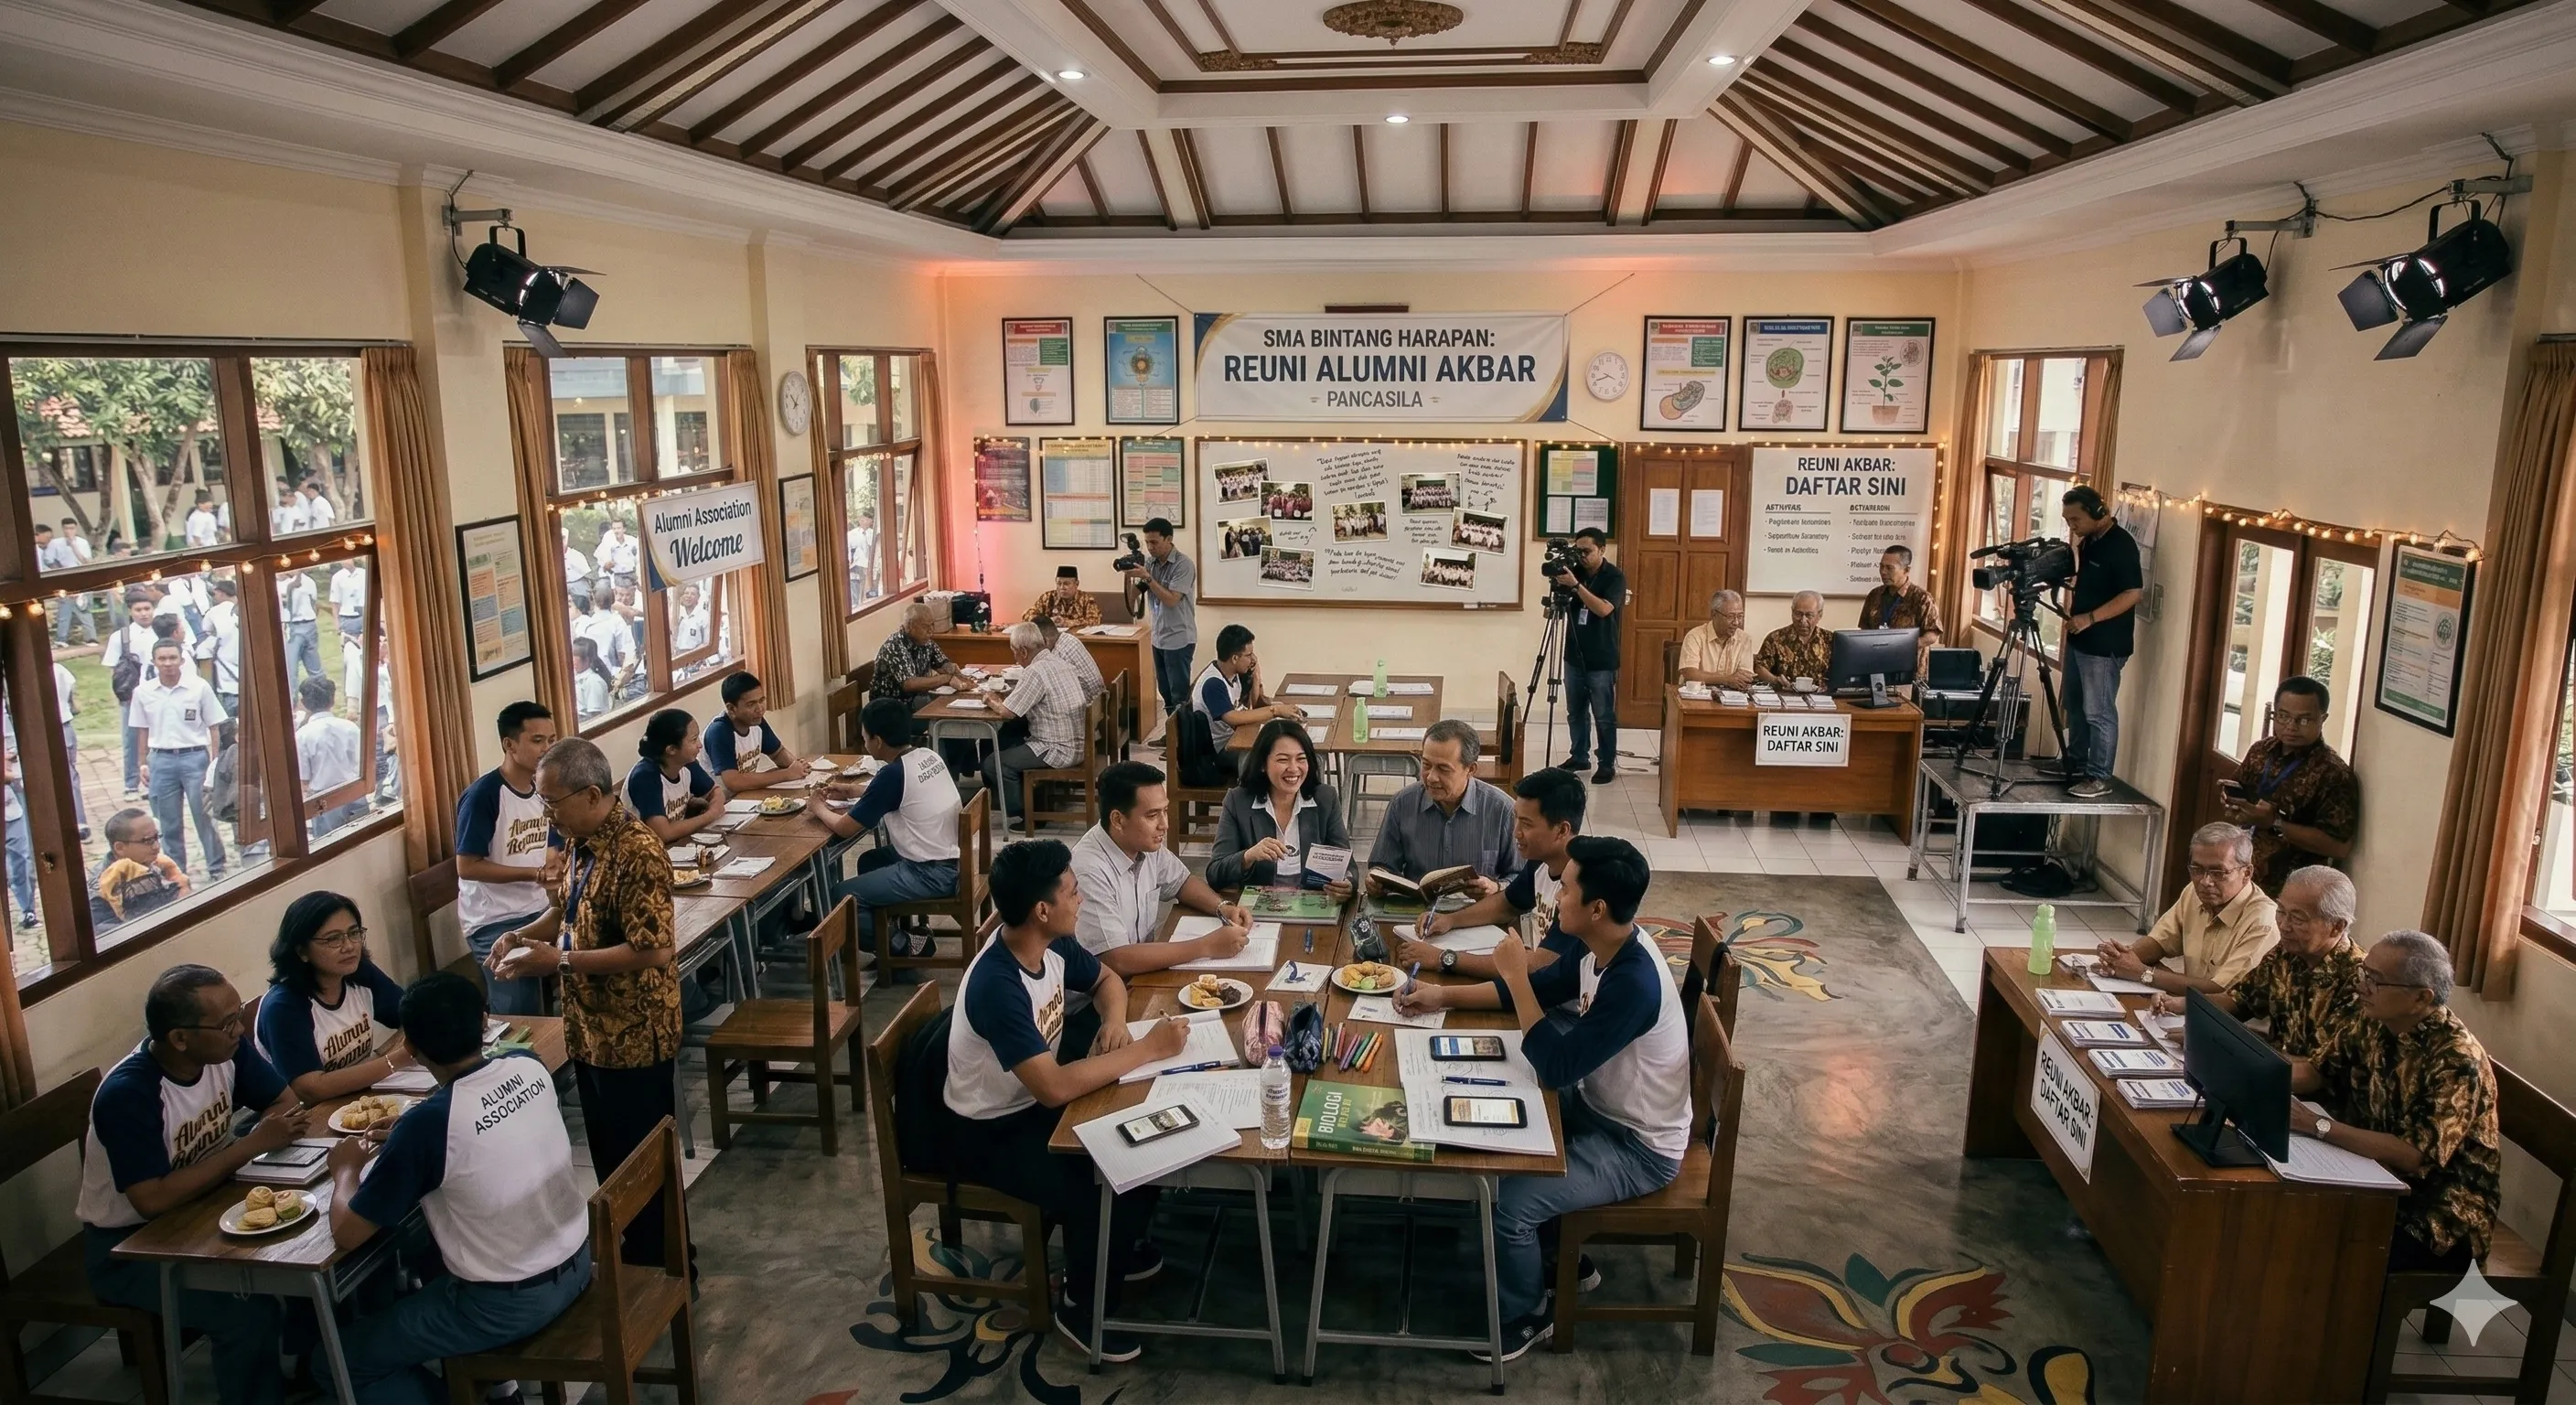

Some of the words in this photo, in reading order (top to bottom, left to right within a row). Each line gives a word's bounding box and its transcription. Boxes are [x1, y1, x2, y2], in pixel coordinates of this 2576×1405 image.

[1263, 328, 1305, 348] SMA
[1311, 328, 1392, 348] BINTANG
[1399, 328, 1495, 348] HARAPAN:
[1224, 355, 1306, 382] REUNI
[1315, 355, 1426, 382] ALUMNI
[1435, 355, 1536, 382] AKBAR
[1327, 391, 1423, 408] PANCASILA
[1798, 456, 1840, 471] REUNI
[1843, 457, 1895, 472] AKBAR:
[1786, 477, 1862, 496] DAFTAR
[1867, 477, 1906, 497] SINI
[655, 508, 692, 534] Alumni
[695, 499, 752, 527] Association
[670, 533, 745, 568] Welcome
[1763, 725, 1798, 736] REUNI
[1802, 726, 1844, 738] AKBAR:
[1767, 740, 1812, 752] DAFTAR
[1815, 741, 1839, 753] SINI
[2041, 1050, 2064, 1091] REUNI
[475, 1078, 546, 1135] ASSOCIATION
[481, 1073, 524, 1110] ALUMNI
[1317, 1091, 1343, 1134] BIOLOGI
[2040, 1078, 2069, 1131] DAFTAR
[2070, 1117, 2087, 1151] SINI
